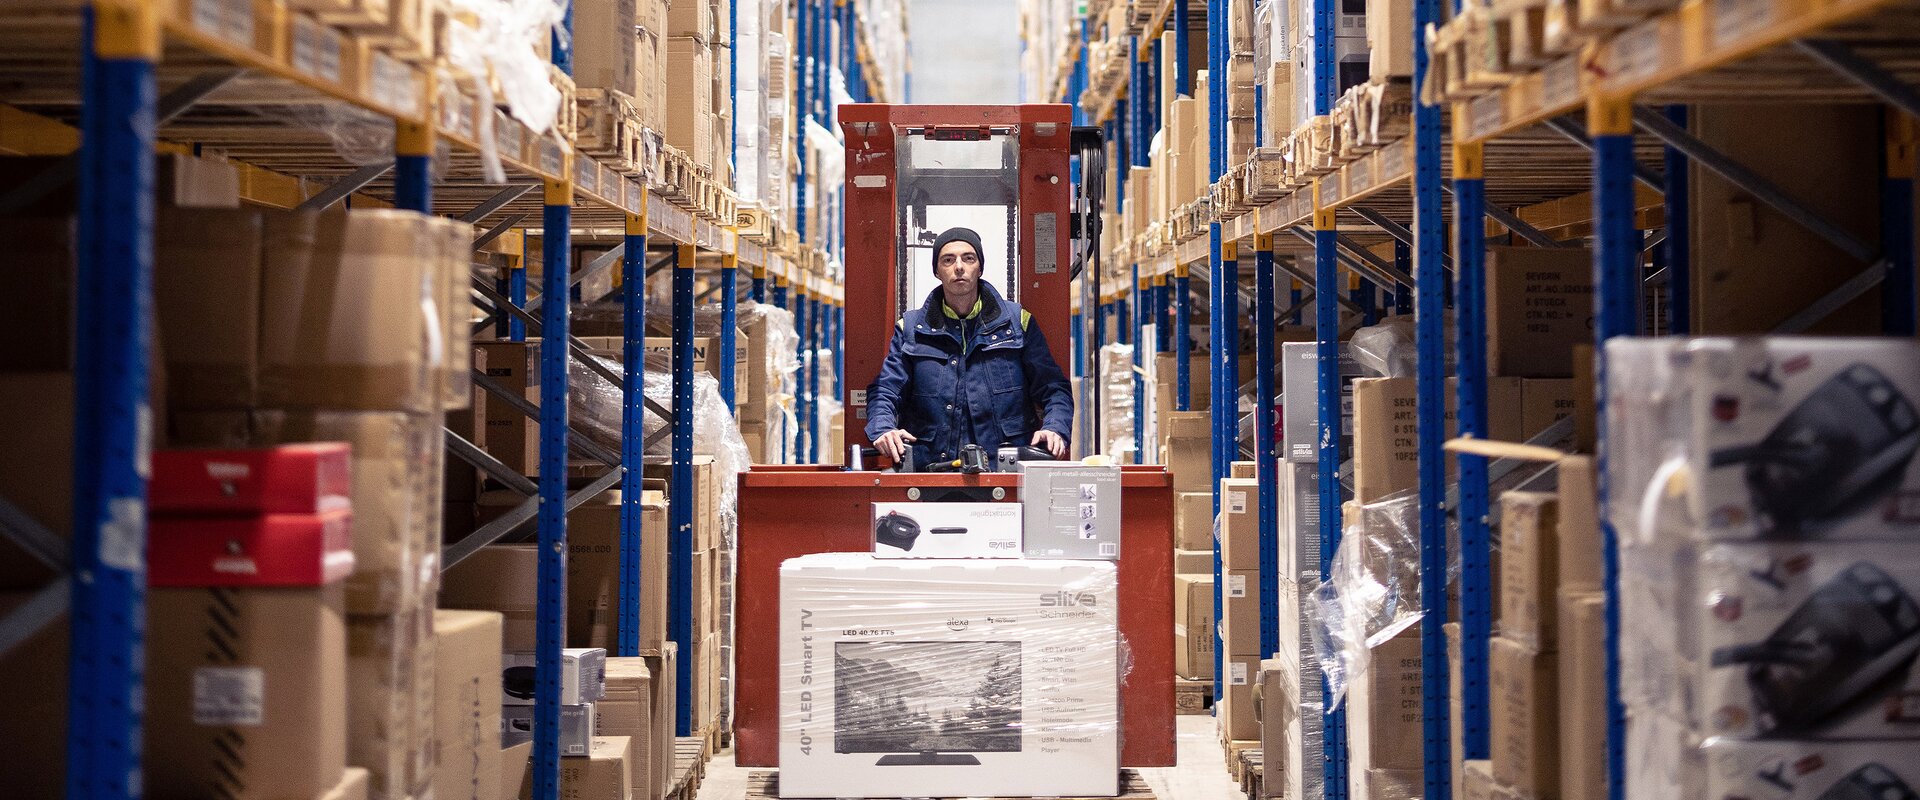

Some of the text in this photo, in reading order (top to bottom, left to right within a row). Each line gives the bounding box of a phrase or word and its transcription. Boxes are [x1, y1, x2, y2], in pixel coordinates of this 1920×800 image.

[1394, 398, 1416, 407] SEVE
[1554, 400, 1576, 408] SEVE
[989, 541, 1017, 550] silva
[1040, 591, 1097, 606] silva
[1040, 609, 1097, 618] Schneider
[801, 608, 812, 631] TV
[947, 617, 969, 626] alexa
[801, 636, 812, 685] Smart
[1401, 659, 1421, 668] SEVE
[801, 691, 812, 722] LED
